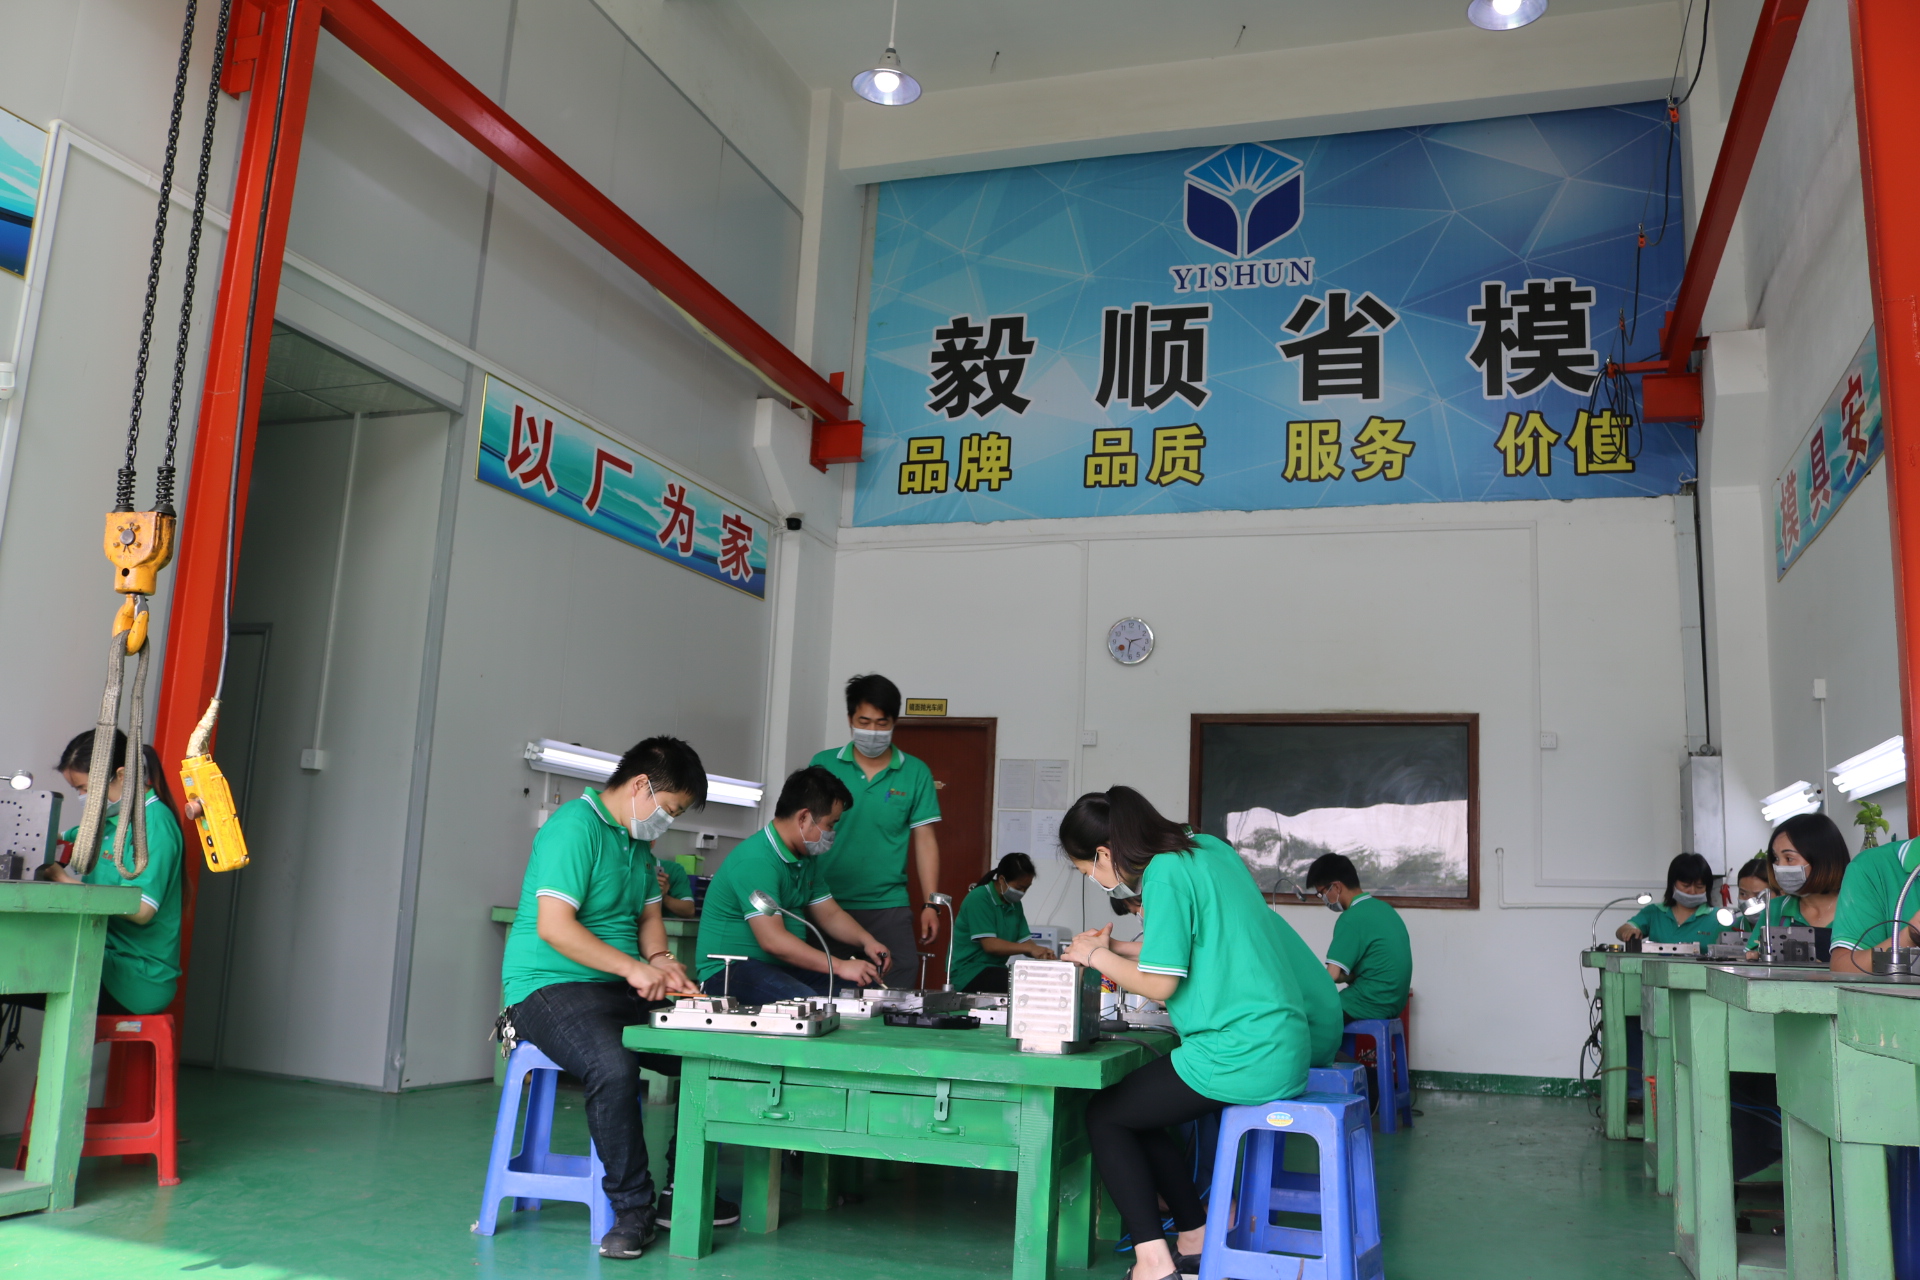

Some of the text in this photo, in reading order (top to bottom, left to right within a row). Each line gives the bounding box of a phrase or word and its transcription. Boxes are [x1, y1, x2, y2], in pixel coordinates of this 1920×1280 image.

[1172, 260, 1311, 290] YISHUN
[507, 404, 753, 578] 以厂为家
[899, 408, 1636, 494] 品牌 品质 服务 价值
